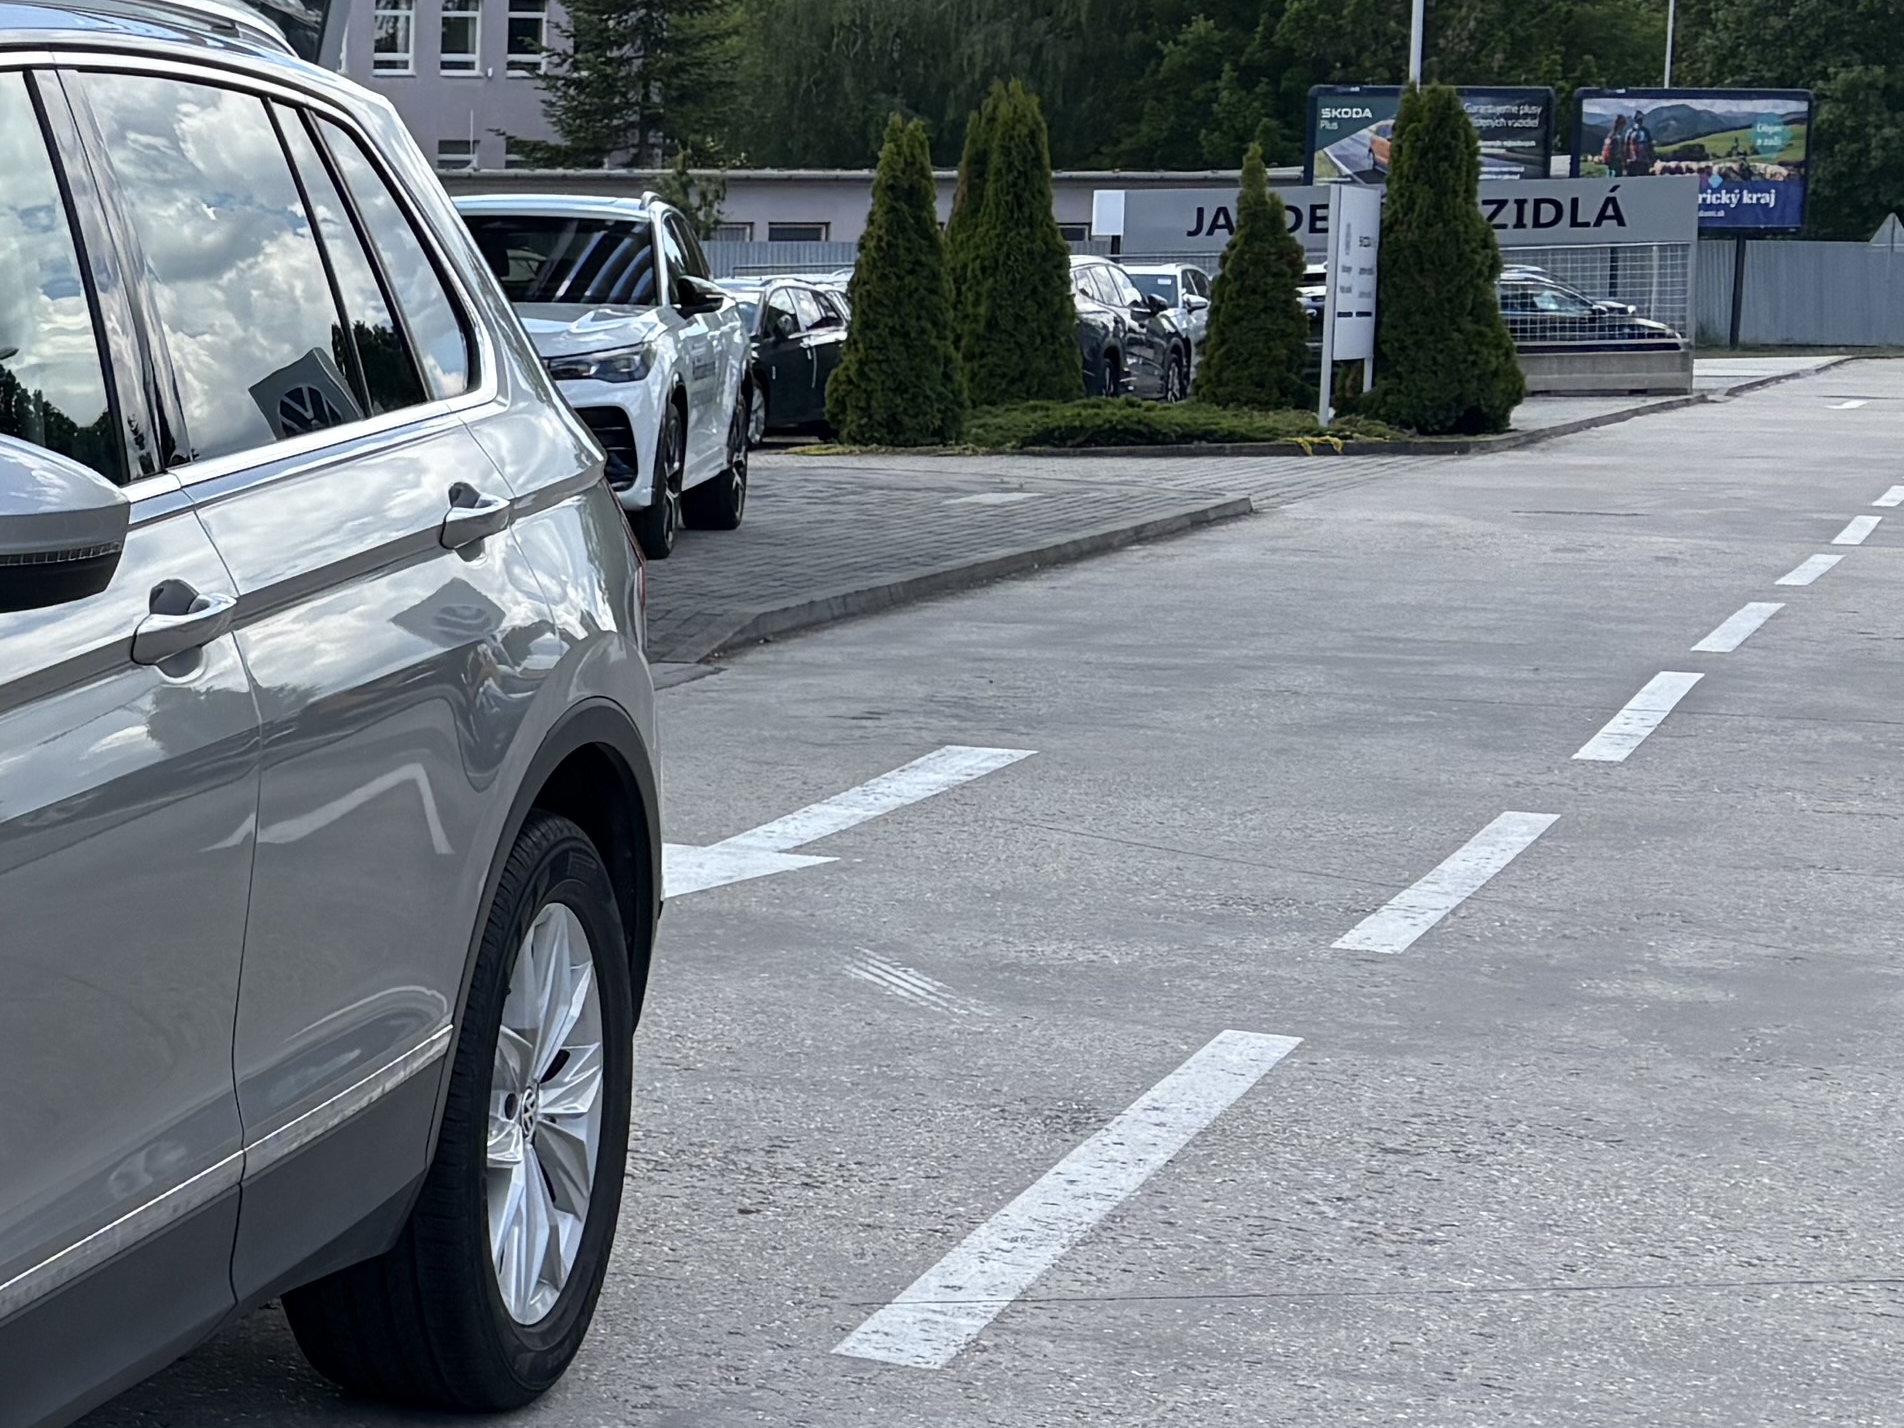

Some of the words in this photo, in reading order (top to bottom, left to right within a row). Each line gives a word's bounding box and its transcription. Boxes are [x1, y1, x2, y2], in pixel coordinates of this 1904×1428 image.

[1482, 184, 1627, 231] ZIDLÁ
[1698, 189, 1740, 208] rický
[1742, 189, 1776, 208] kraj
